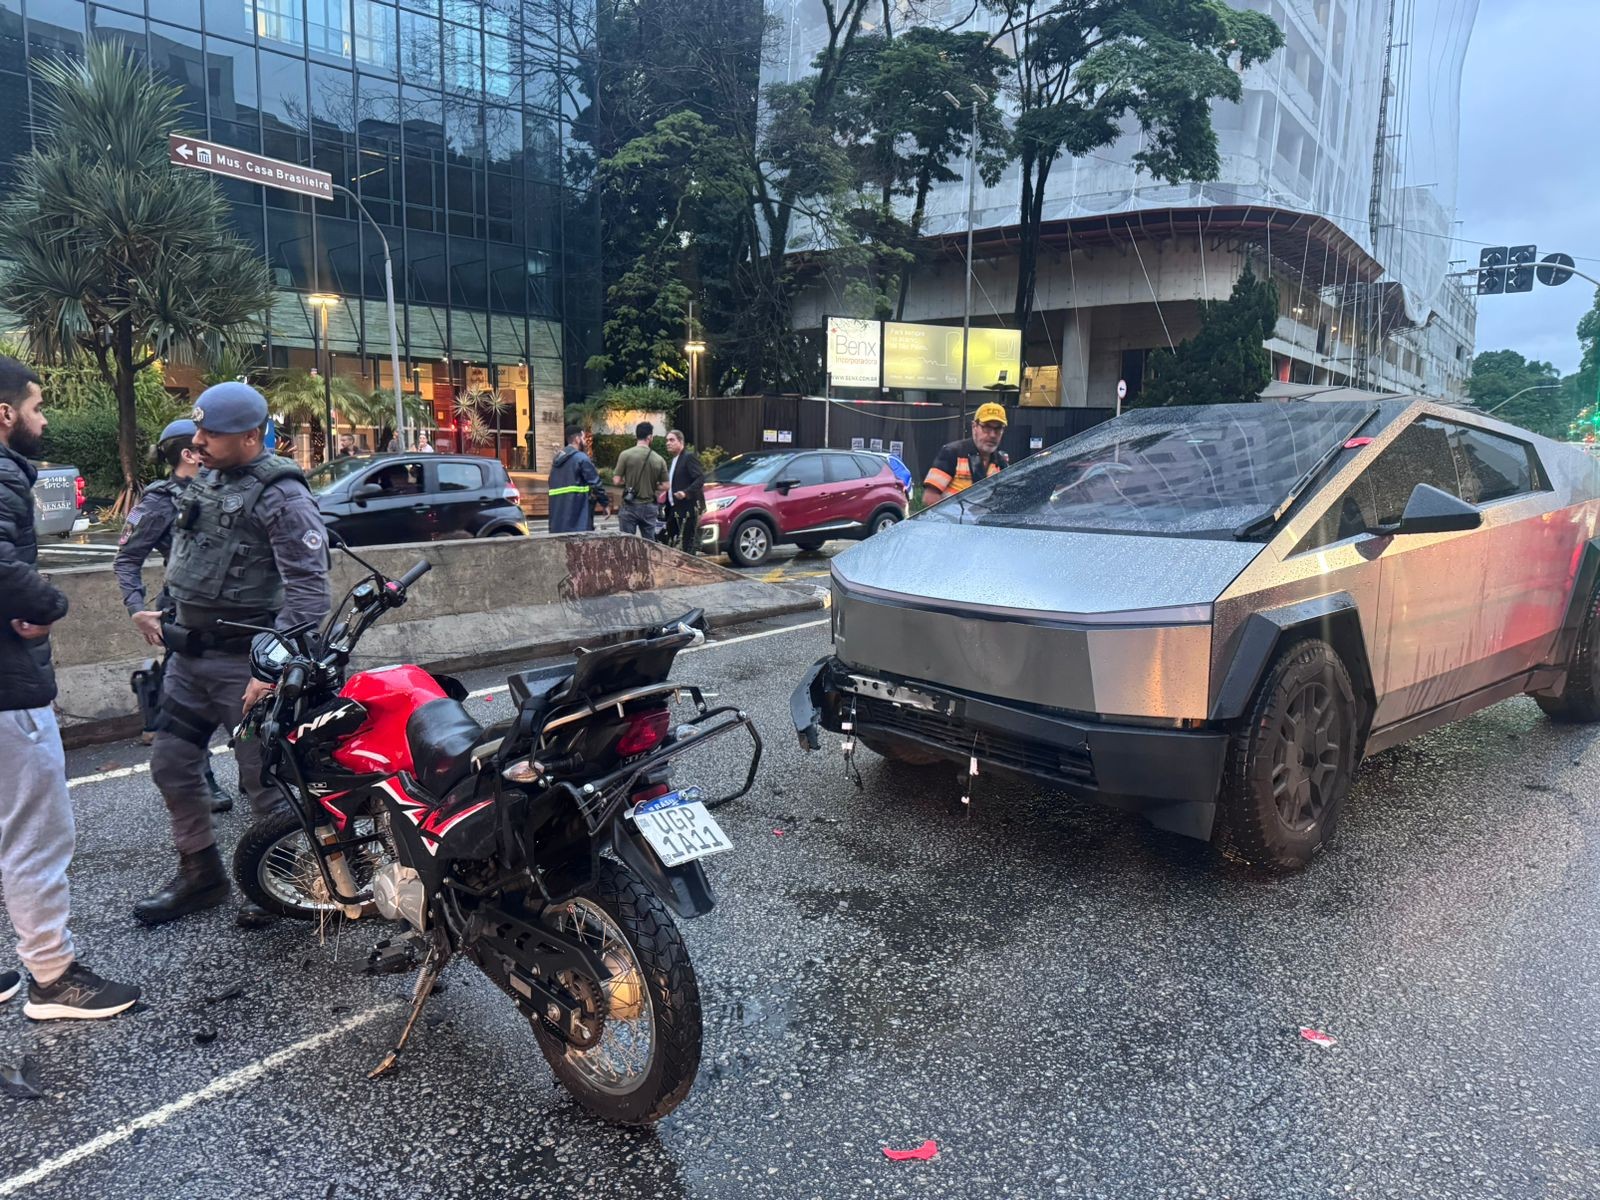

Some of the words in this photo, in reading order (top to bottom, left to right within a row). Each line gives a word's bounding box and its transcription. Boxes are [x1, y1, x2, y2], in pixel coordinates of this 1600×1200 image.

[216, 153, 243, 170] Mus.
[246, 161, 274, 177] Casa
[276, 168, 330, 191] Brasileira
[835, 334, 877, 357] Benx
[650, 806, 697, 835] UGP
[662, 825, 724, 858] 1A11
